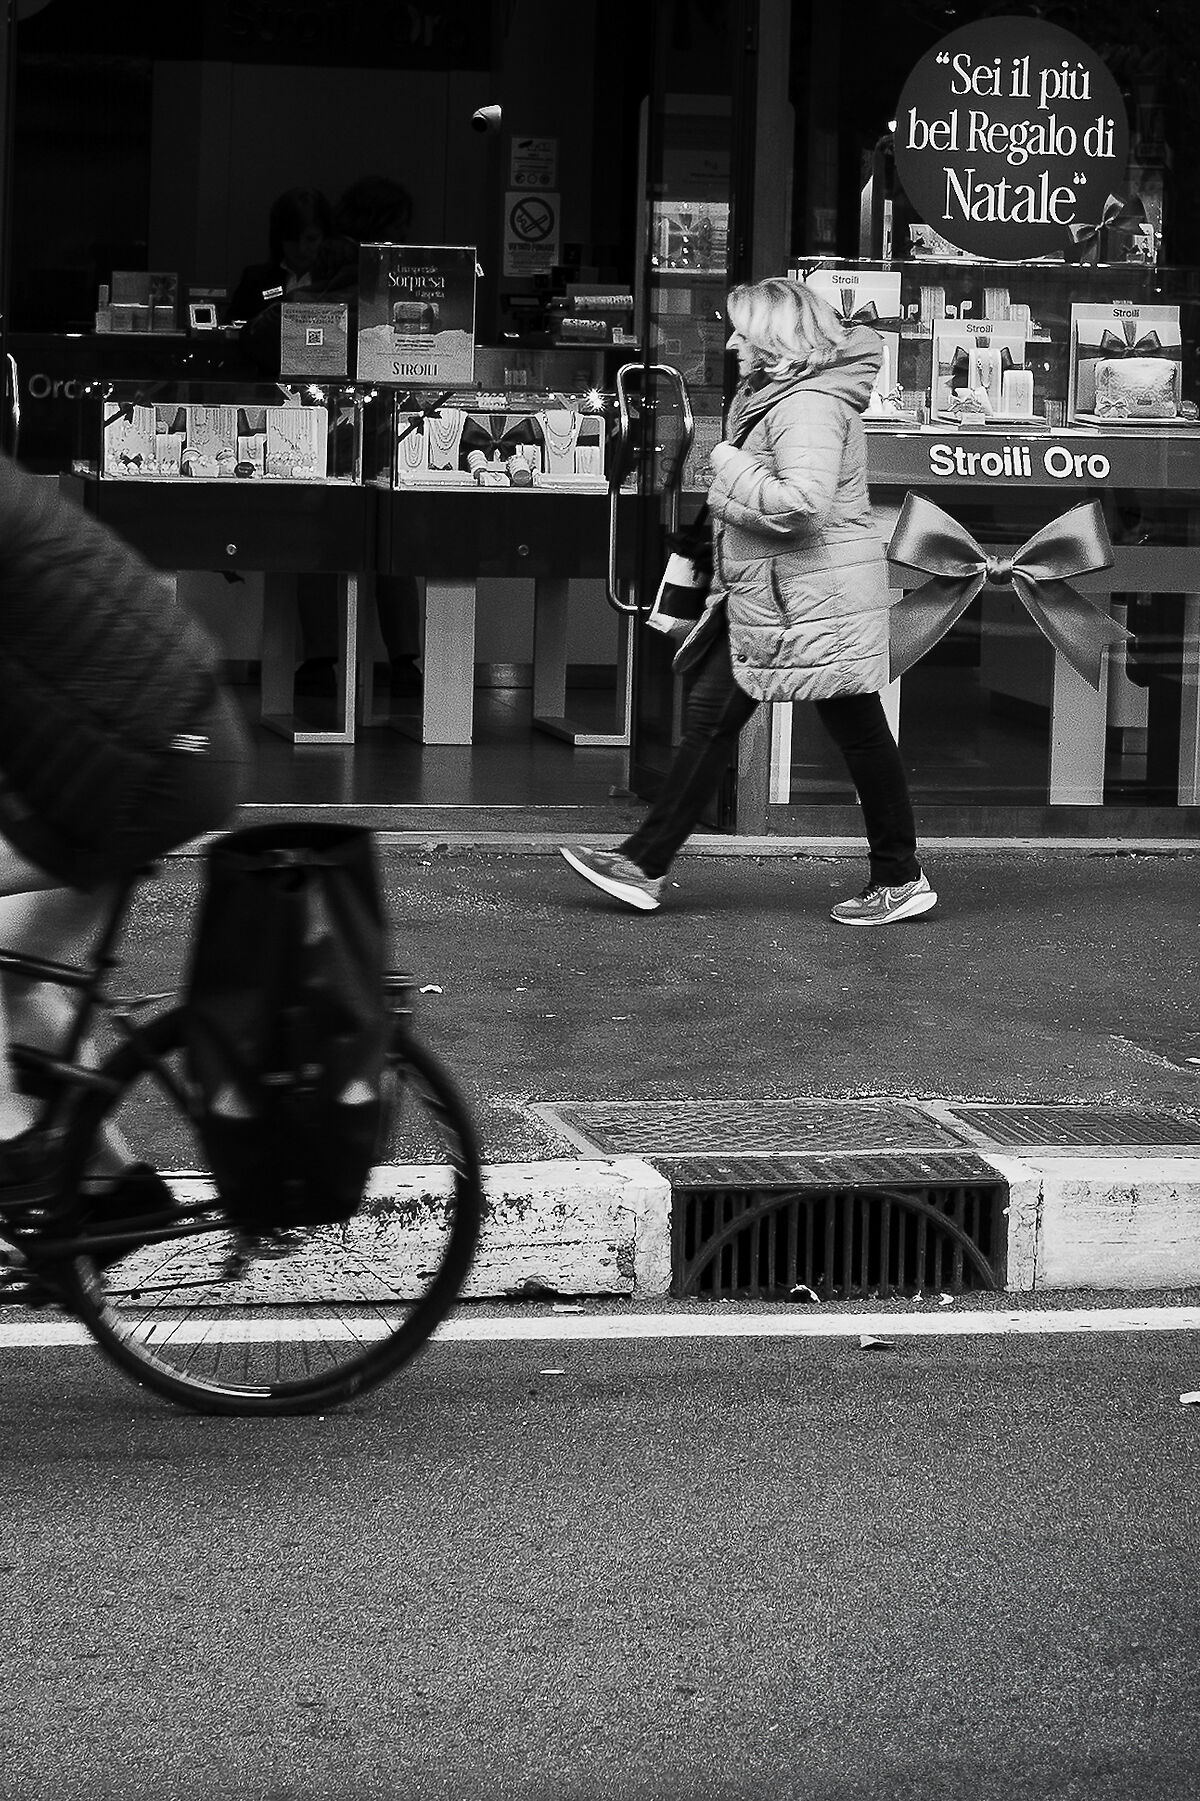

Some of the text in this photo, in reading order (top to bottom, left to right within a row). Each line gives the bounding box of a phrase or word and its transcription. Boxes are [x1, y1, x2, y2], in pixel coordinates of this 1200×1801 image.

[1009, 55, 1031, 98] il
[1037, 60, 1092, 110] più
[905, 106, 1116, 166] bel Regalo di
[929, 444, 1111, 479] Stroili Oro
